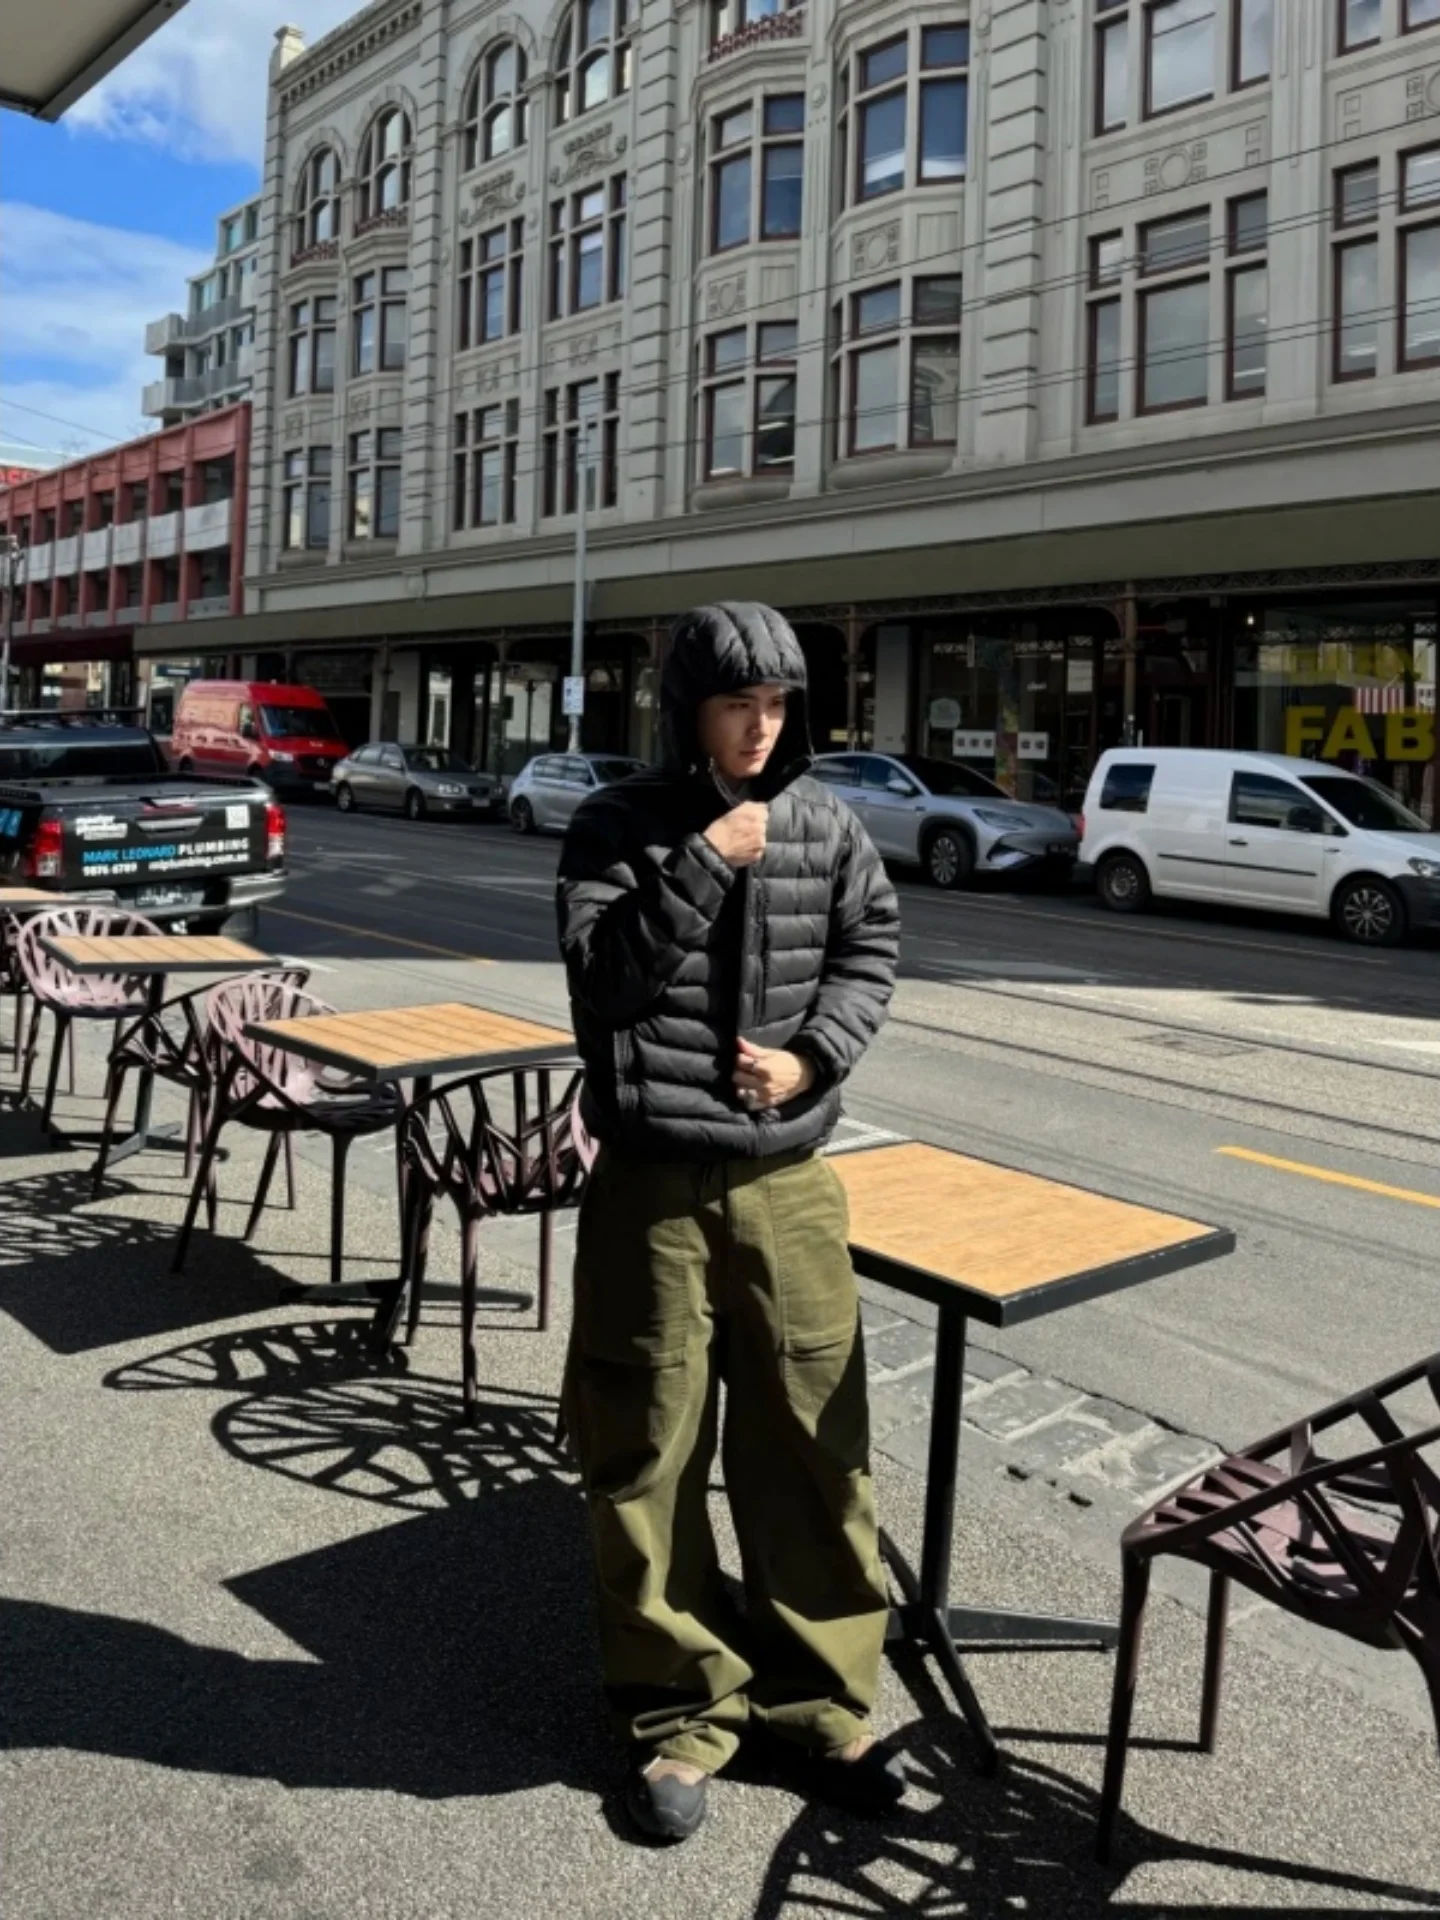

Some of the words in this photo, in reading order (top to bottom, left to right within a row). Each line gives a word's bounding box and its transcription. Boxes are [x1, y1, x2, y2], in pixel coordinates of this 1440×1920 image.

[1285, 704, 1435, 761] FAB
[82, 849, 119, 863] MARK
[122, 844, 176, 860] LEONARD
[178, 837, 250, 856] PLUMBING
